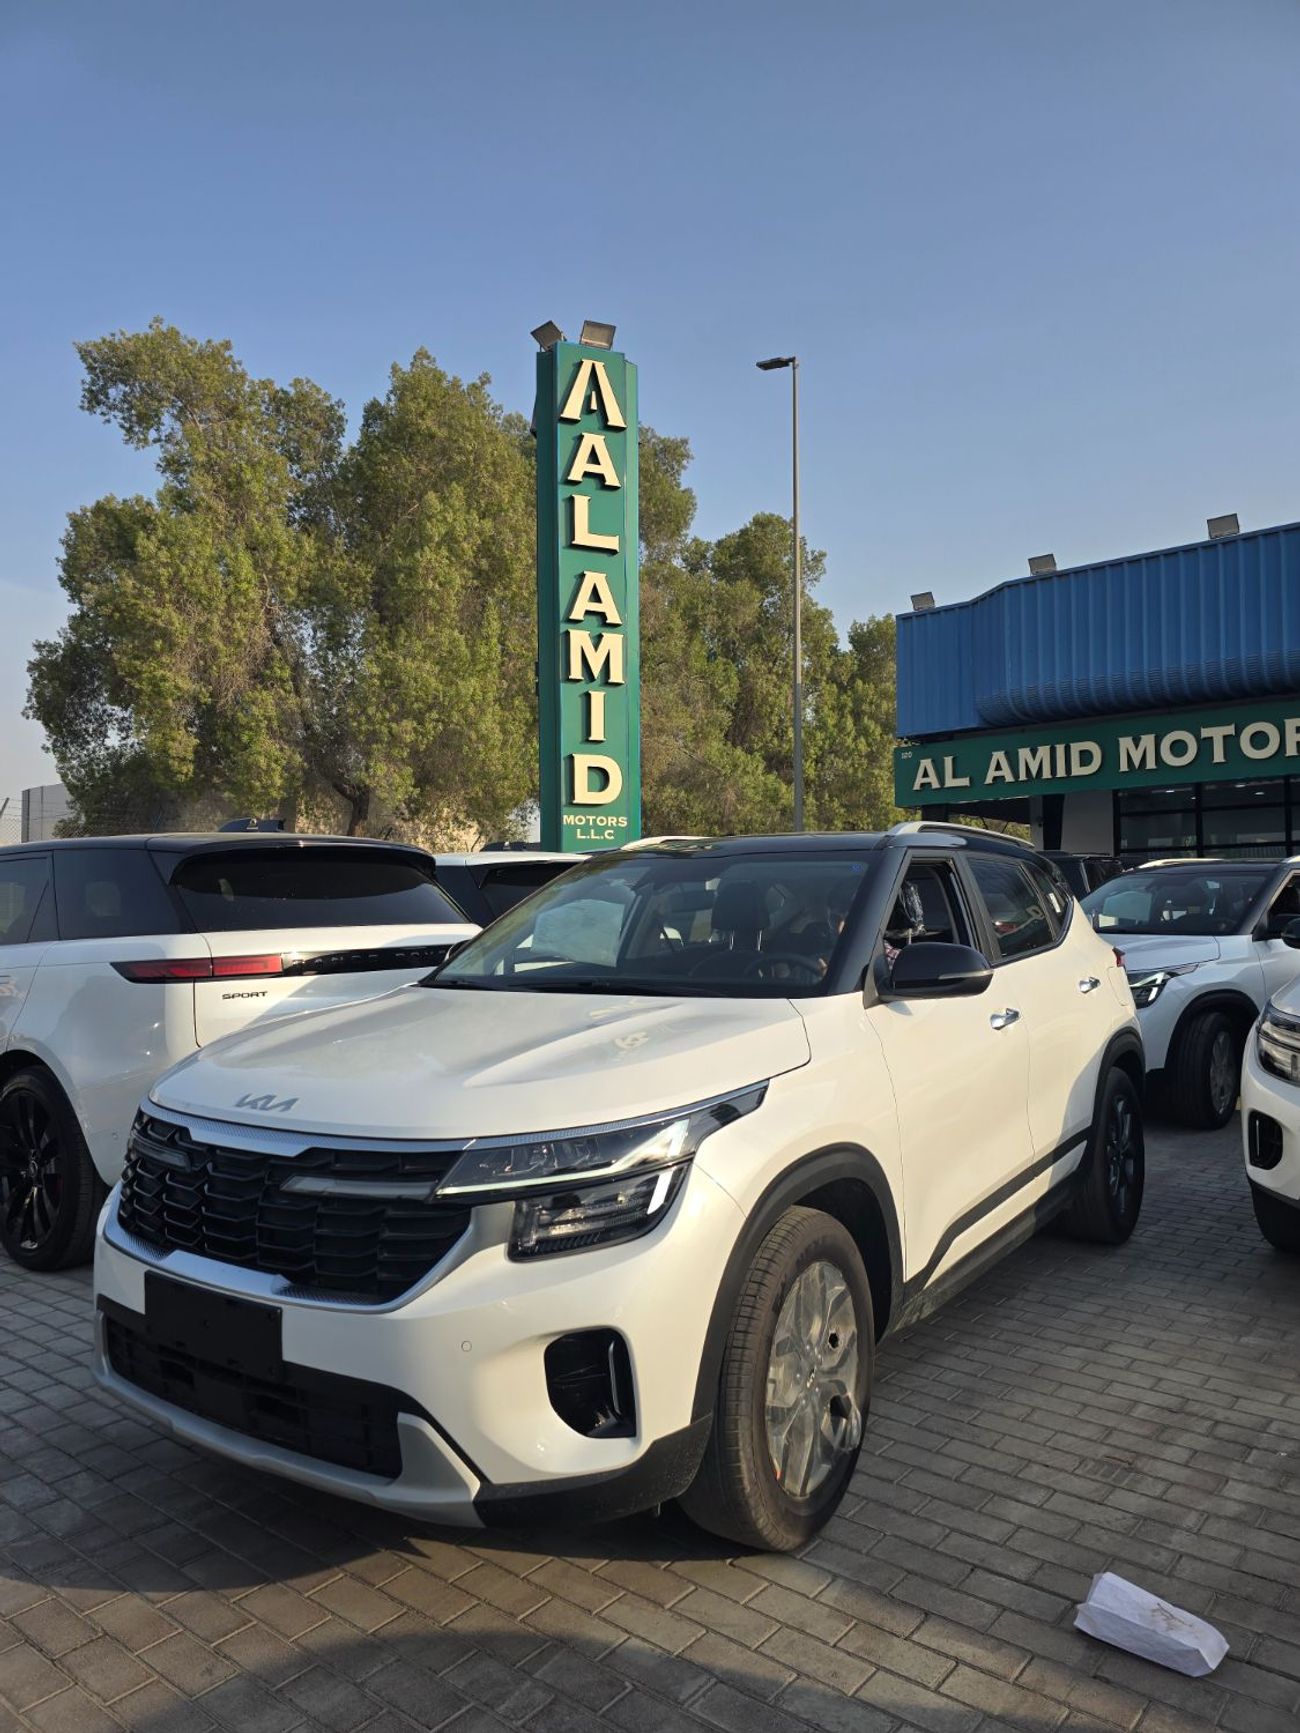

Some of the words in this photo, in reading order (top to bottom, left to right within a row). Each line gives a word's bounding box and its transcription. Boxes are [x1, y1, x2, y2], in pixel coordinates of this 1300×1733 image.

[912, 755, 971, 791] AL
[984, 740, 1102, 786] AMID
[563, 815, 628, 827] MOTORS
[576, 828, 615, 840] L.L.C
[222, 990, 268, 1000] SPORT
